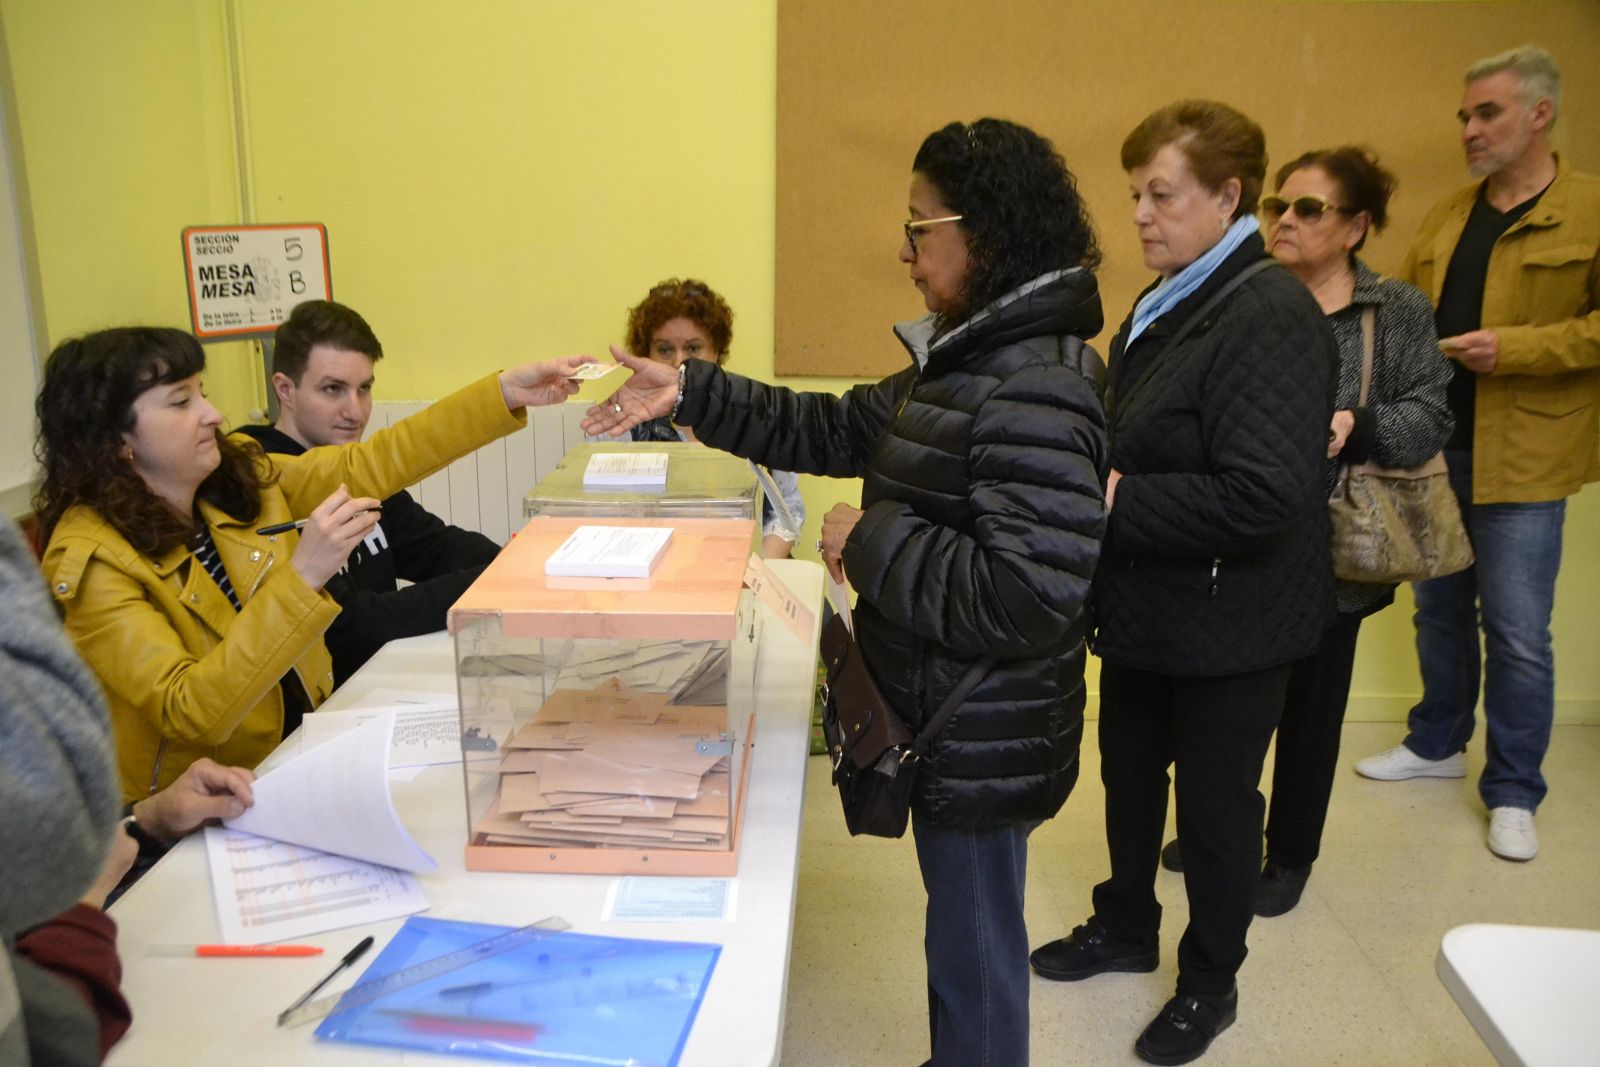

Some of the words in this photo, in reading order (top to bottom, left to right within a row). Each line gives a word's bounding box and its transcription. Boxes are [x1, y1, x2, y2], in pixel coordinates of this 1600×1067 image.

[284, 237, 303, 261] 5
[199, 263, 255, 281] MESA
[202, 281, 256, 299] MESA
[289, 271, 306, 294] B
